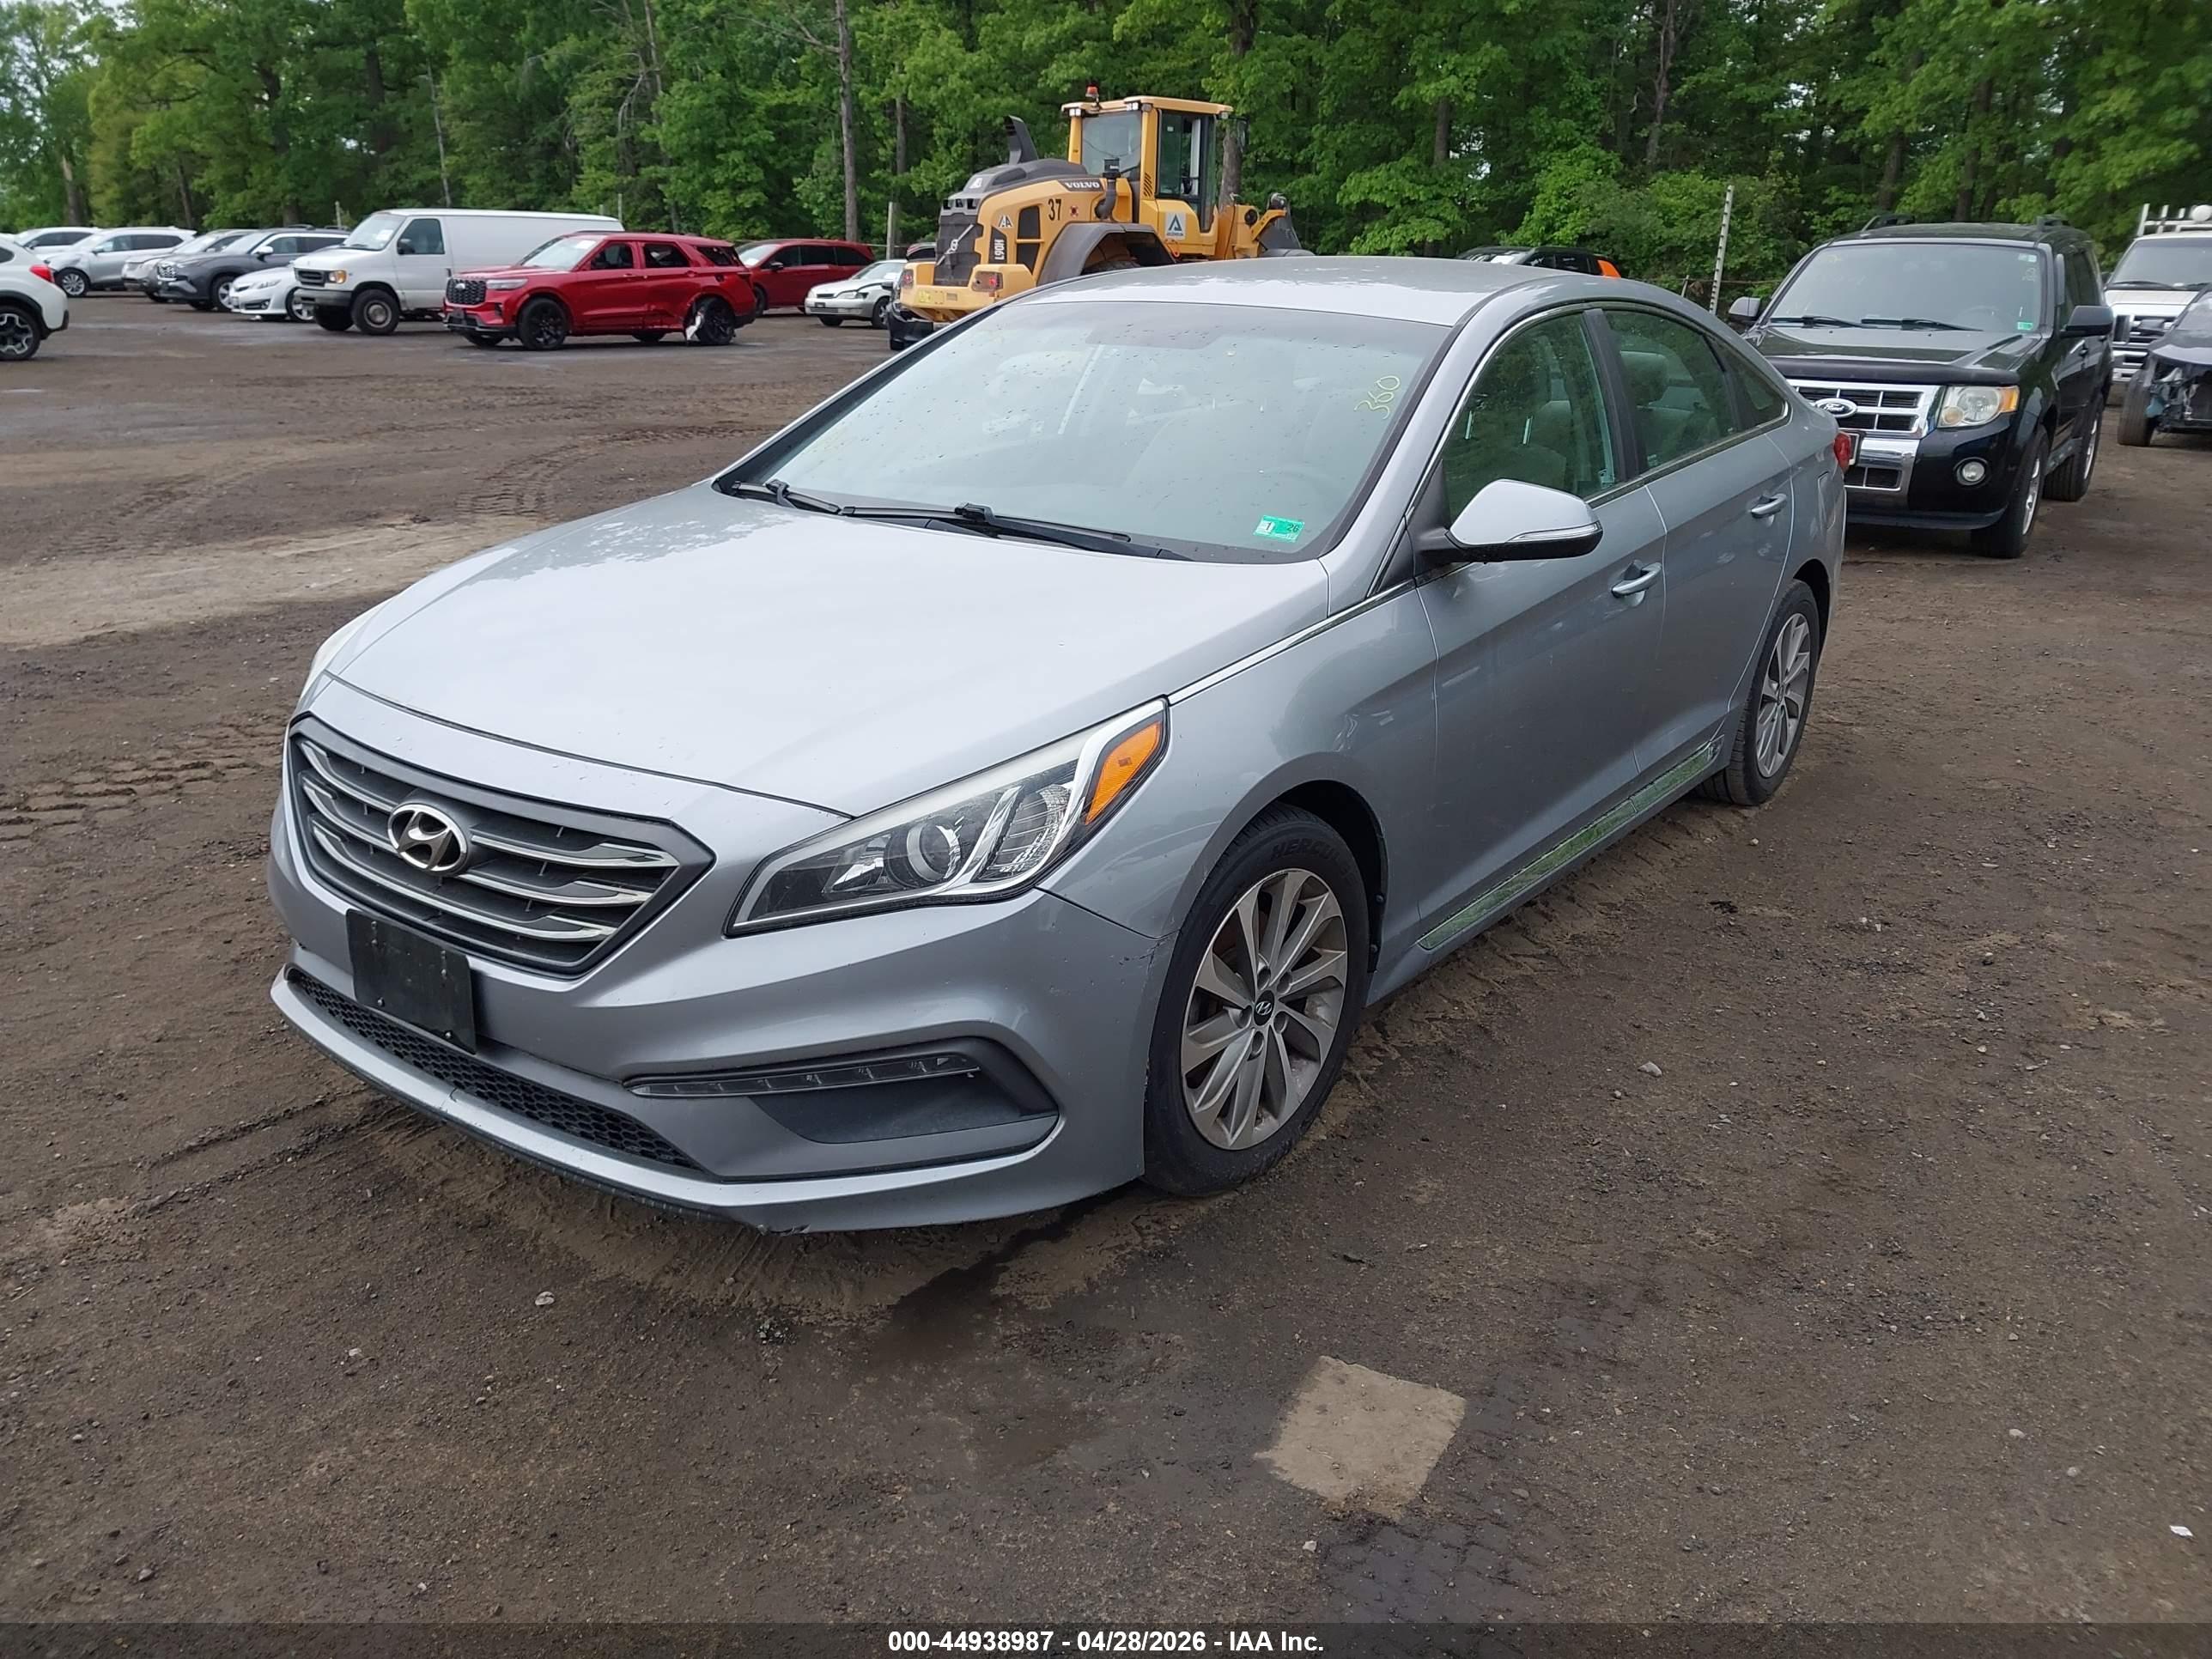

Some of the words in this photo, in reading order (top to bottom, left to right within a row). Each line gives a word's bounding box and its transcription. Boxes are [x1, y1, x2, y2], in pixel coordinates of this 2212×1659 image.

[1048, 198, 1061, 221] 37
[994, 239, 1005, 260] L90H
[1354, 375, 1401, 420] 360
